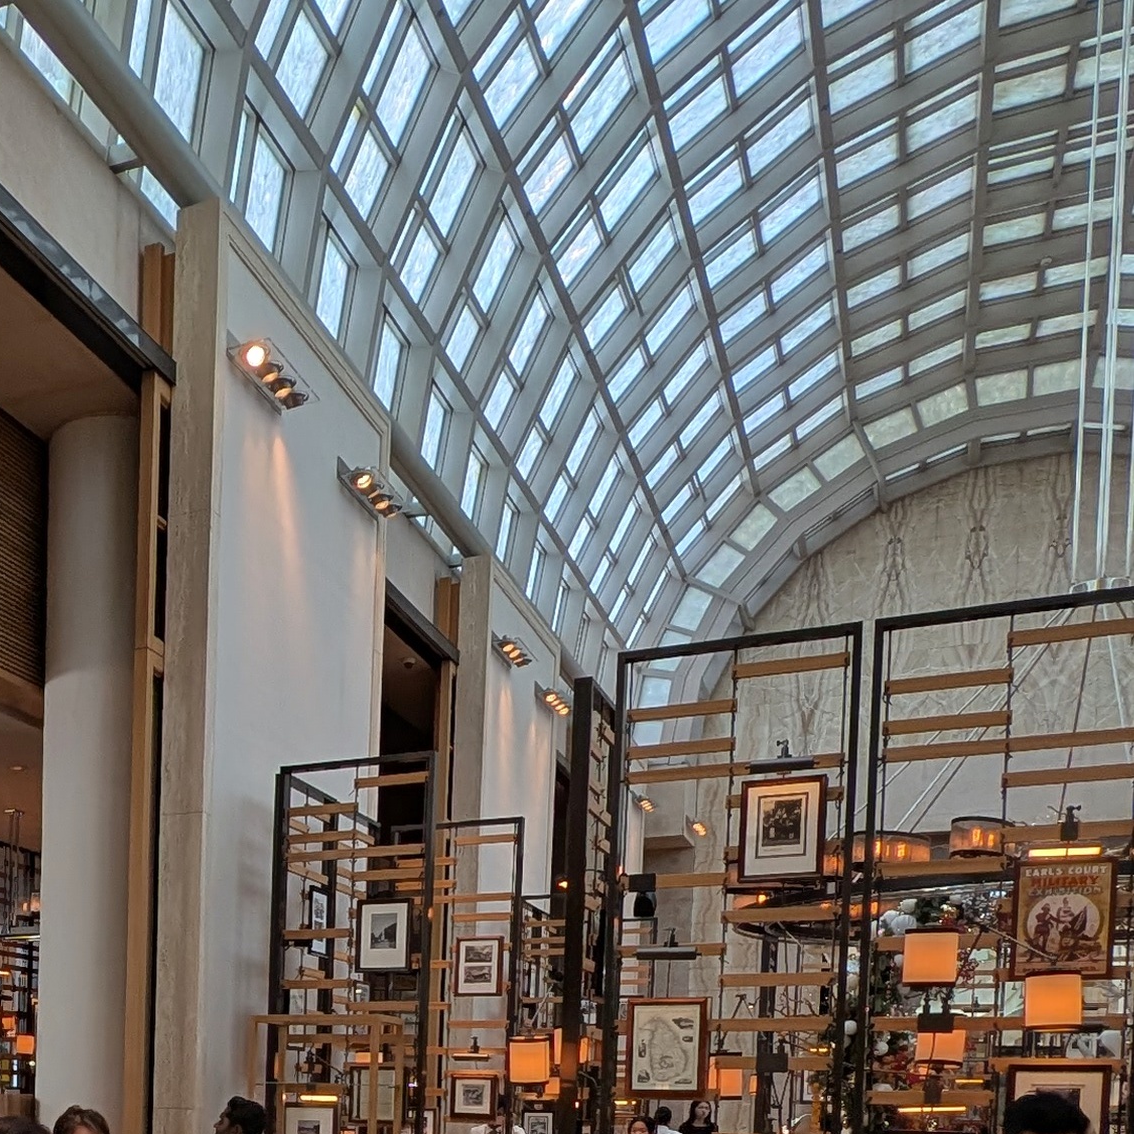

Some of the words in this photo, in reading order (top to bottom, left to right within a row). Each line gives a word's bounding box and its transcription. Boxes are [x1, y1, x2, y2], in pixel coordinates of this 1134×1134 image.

[1025, 867, 1063, 877] EARLS
[1068, 865, 1108, 875] COURT
[1030, 875, 1099, 888] MILITARY
[1028, 886, 1103, 897] EXHIBITION
